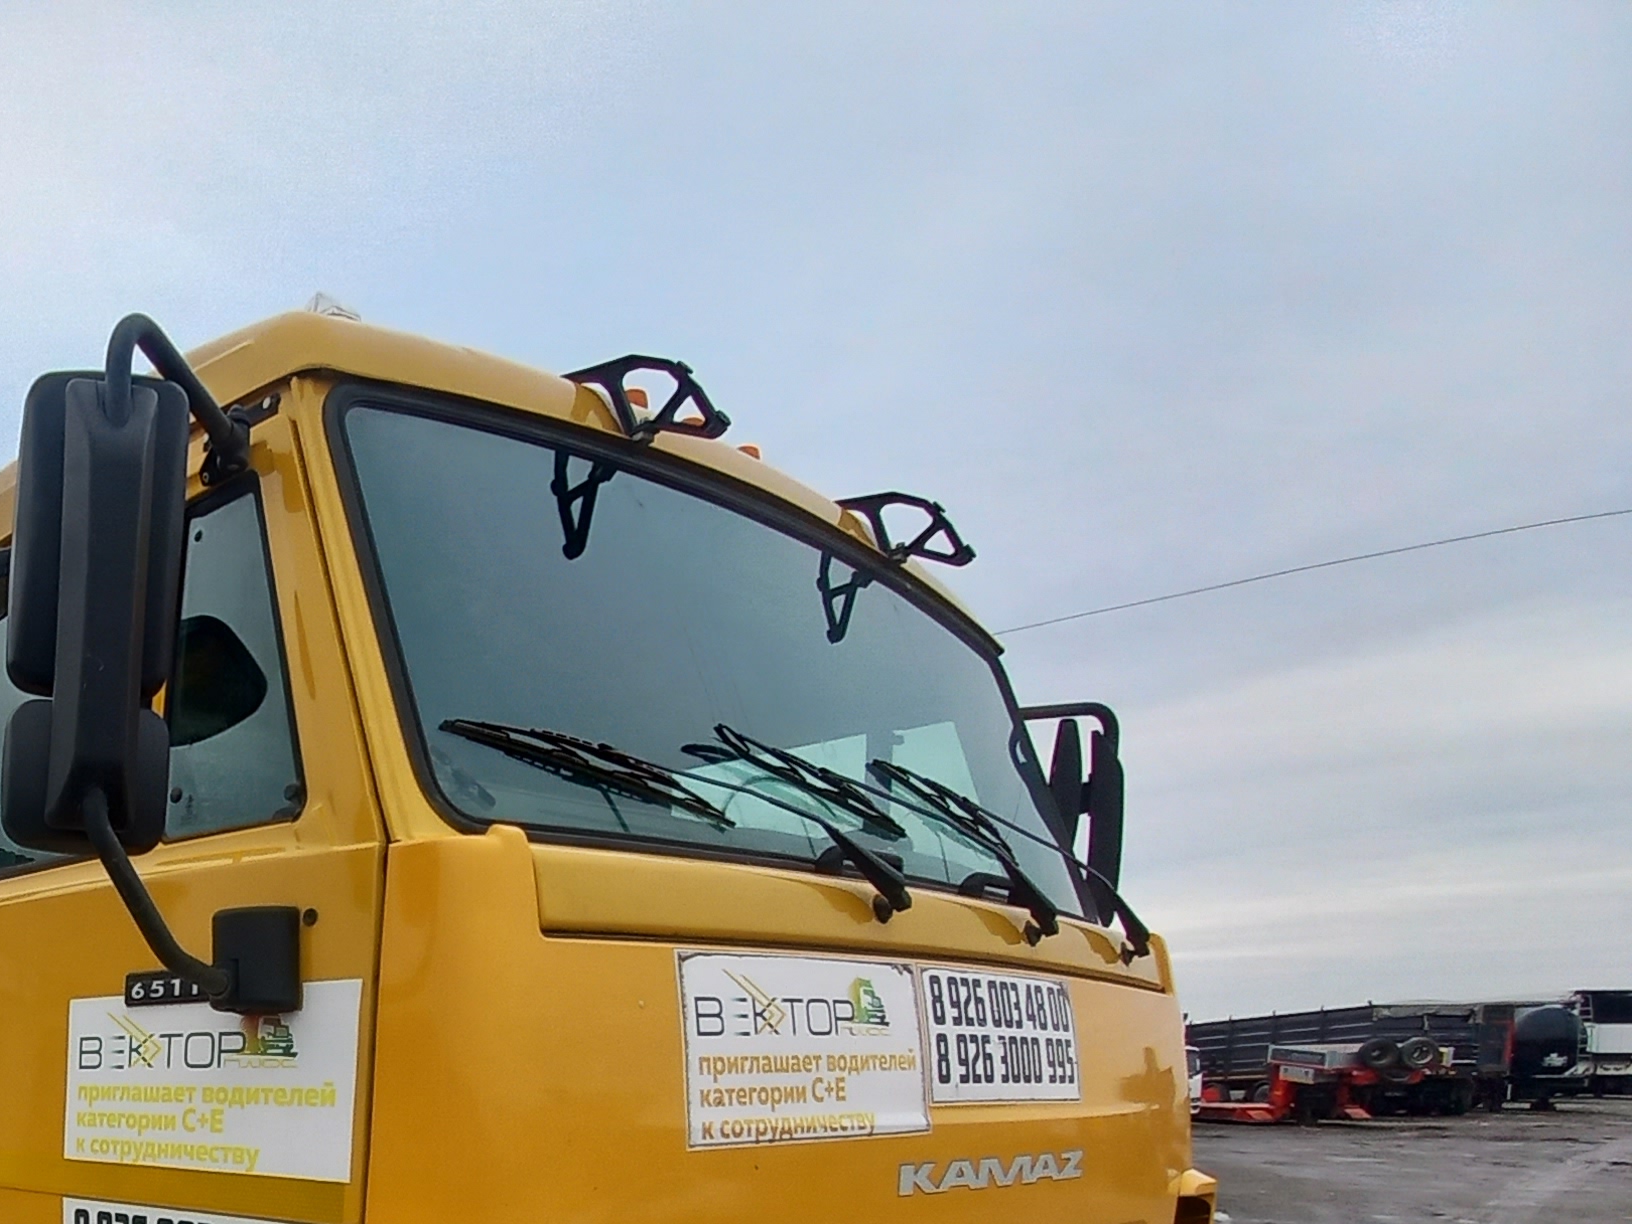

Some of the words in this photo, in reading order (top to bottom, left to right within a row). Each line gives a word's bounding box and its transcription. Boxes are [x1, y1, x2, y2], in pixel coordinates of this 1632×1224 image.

[929, 974, 946, 1026] 8
[947, 976, 987, 1027] 926
[987, 980, 1023, 1029] 003
[1025, 984, 1048, 1031] 48
[1046, 986, 1070, 1032] 00
[698, 1054, 823, 1082] приглашает
[826, 1048, 916, 1074] водителей
[936, 1032, 951, 1084] 8
[956, 1033, 994, 1084] 926
[997, 1035, 1043, 1084] 3000
[1045, 1037, 1075, 1084] 995
[77, 1085, 197, 1107] приглашает
[201, 1082, 337, 1109] водителей
[699, 1085, 807, 1112] категории
[812, 1077, 847, 1103] С+Е
[76, 1111, 176, 1136] категории
[181, 1107, 225, 1133] С+Е
[701, 1121, 715, 1140] к
[720, 1112, 876, 1144] сотрудничеству
[76, 1138, 86, 1153] к
[90, 1139, 260, 1171] сотрудничеству
[898, 1151, 1084, 1197] KAMAZ
